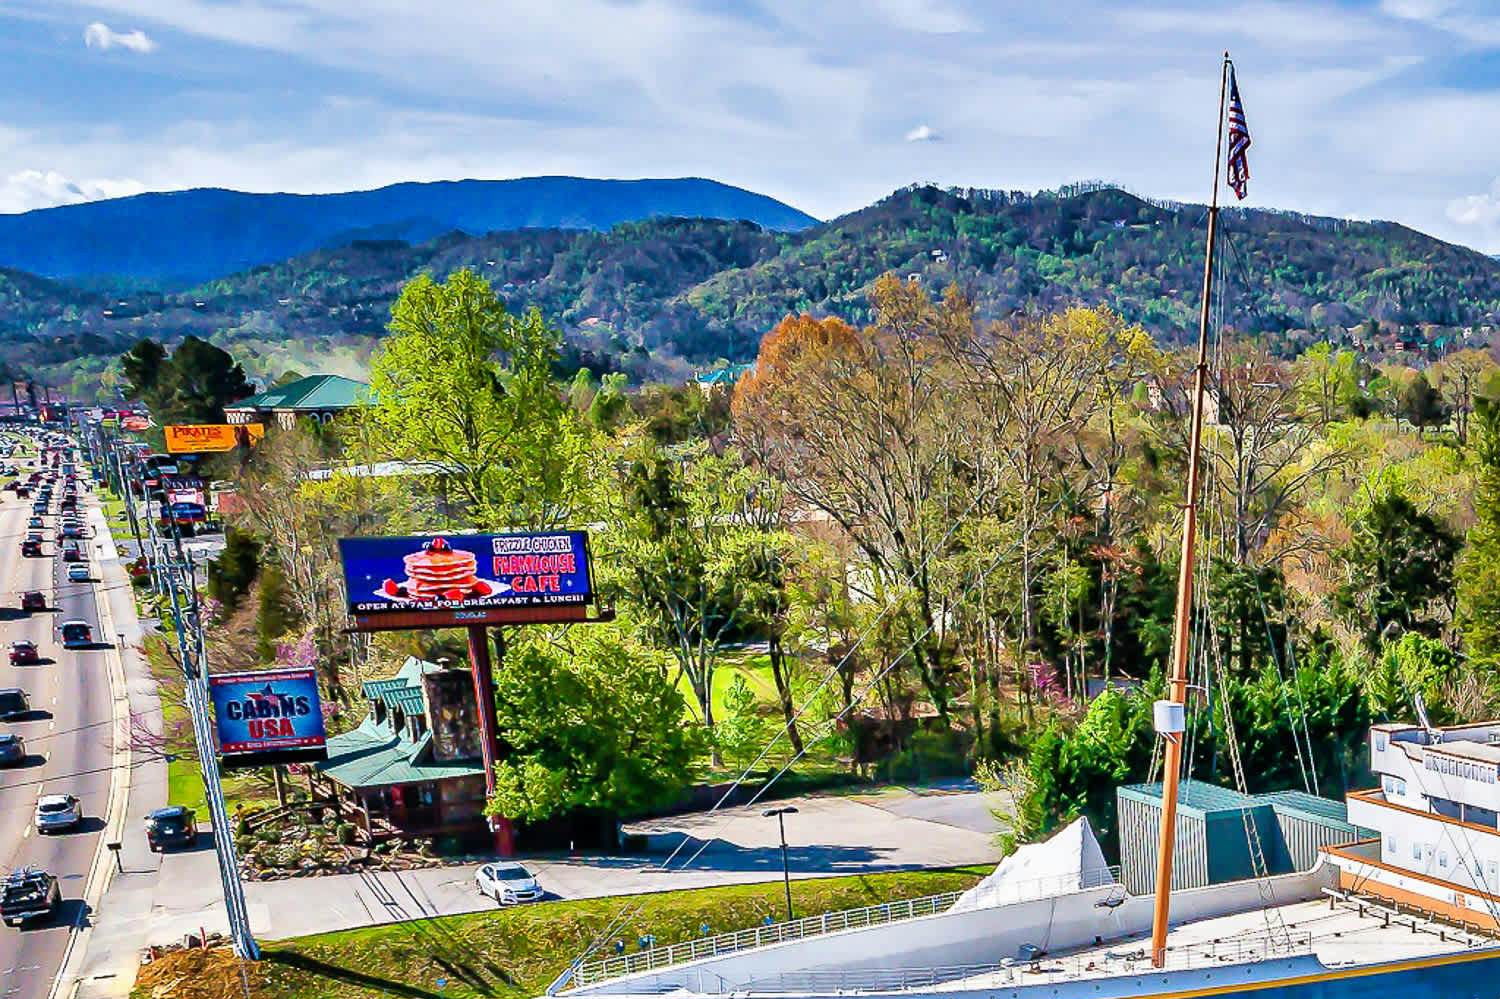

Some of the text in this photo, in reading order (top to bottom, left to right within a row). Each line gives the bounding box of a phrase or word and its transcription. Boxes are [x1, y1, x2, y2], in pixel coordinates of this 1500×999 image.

[493, 554, 576, 576] FARMHOUSE
[391, 601, 407, 609] AT
[437, 599, 460, 607] FOR
[463, 597, 528, 606] BREAKFAST
[248, 718, 295, 739] USA
